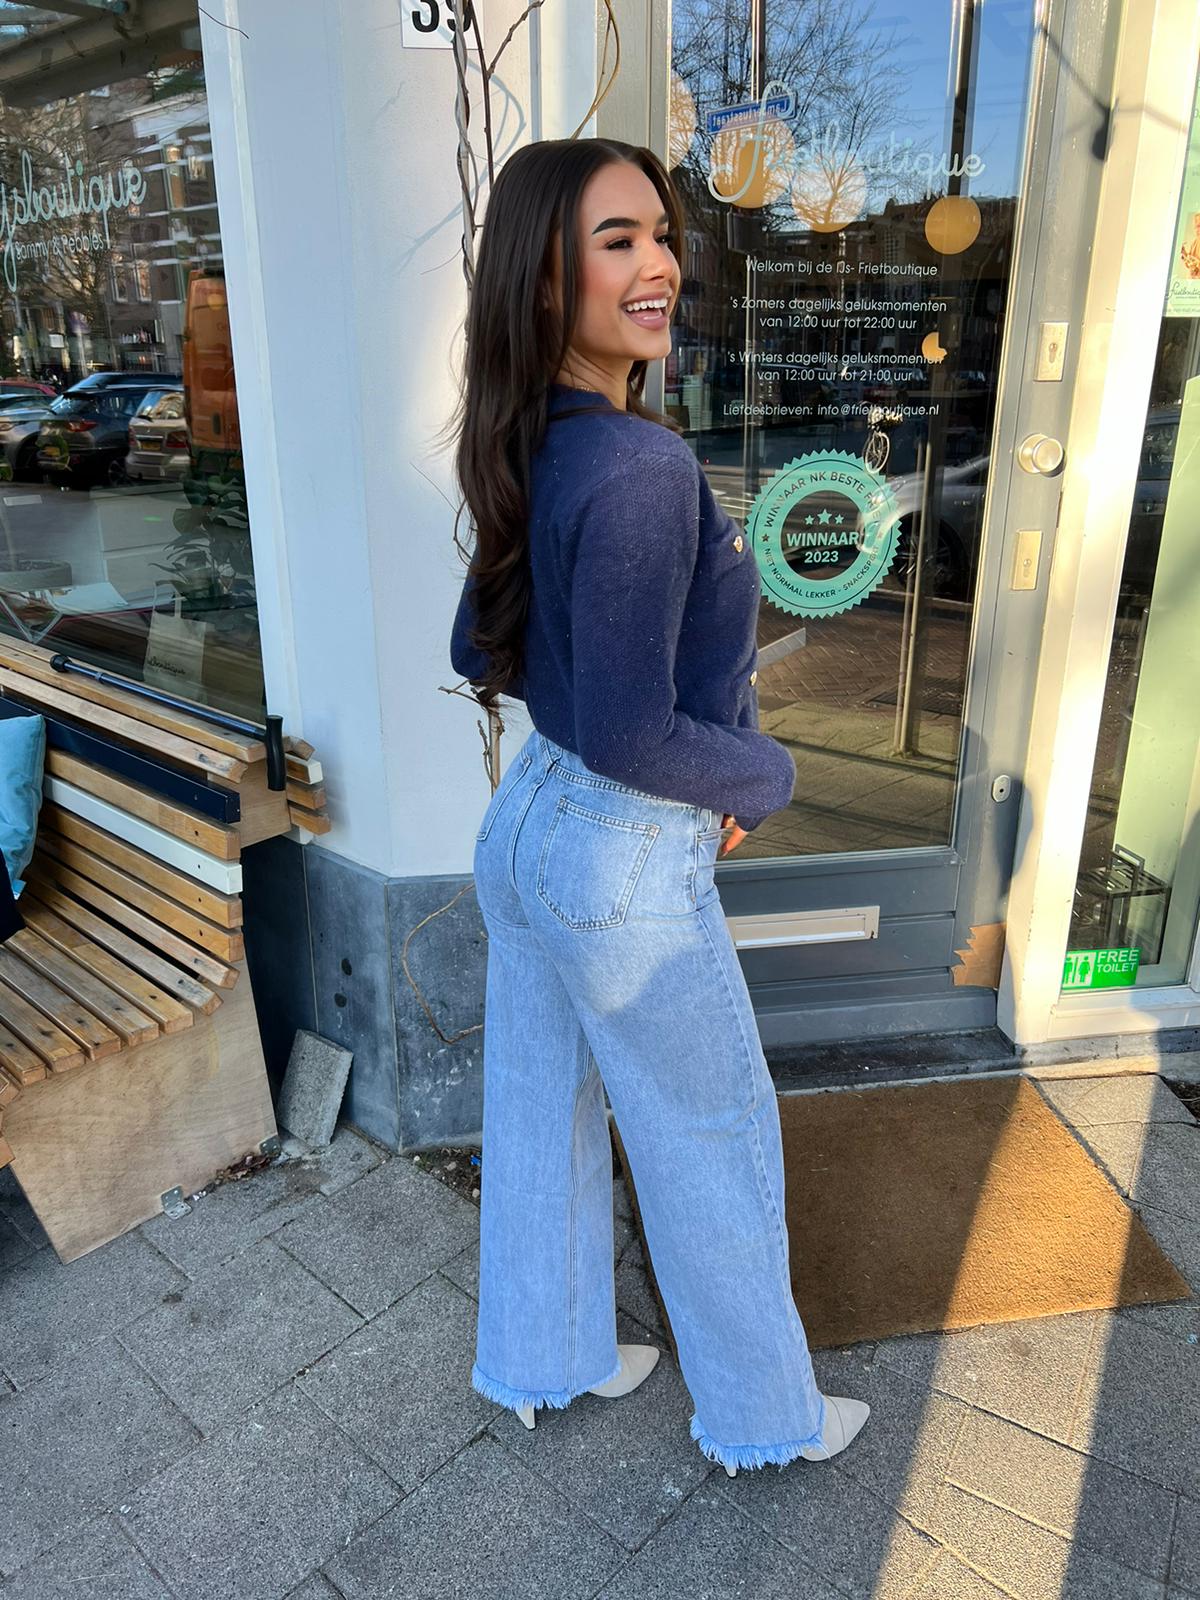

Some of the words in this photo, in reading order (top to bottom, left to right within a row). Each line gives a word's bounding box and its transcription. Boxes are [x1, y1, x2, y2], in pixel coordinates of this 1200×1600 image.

[62, 229, 105, 253] Pebbles
[745, 259, 795, 273] Welkom
[797, 260, 813, 275] bij
[815, 260, 833, 273] de
[858, 262, 938, 277] Frietboutique
[729, 296, 738, 309] 's
[741, 296, 786, 310] Zomers
[788, 298, 842, 312] dagelijks
[844, 298, 947, 313] geluksmomenten
[759, 317, 783, 328] van
[787, 315, 819, 329] 12:00
[821, 317, 841, 329] uur
[843, 316, 861, 329] tot
[863, 316, 896, 329] 22:00
[897, 318, 918, 330] uur
[727, 351, 736, 363] 's
[738, 351, 783, 364] Winters
[785, 351, 839, 366] dagelijks
[757, 371, 781, 381] van
[784, 369, 816, 381] 12:00
[817, 371, 837, 381] uur
[839, 368, 857, 382] tot
[859, 369, 891, 382] 21:00
[893, 373, 913, 382] uur
[723, 403, 814, 417] Liefdesbrieven:
[763, 477, 806, 528] WINNAAR
[809, 471, 827, 483] NK
[830, 471, 866, 494] BESTE
[786, 531, 860, 547] WINNAAR
[804, 550, 840, 564] 2023
[764, 547, 776, 567] NIET
[771, 567, 803, 597] NORMAAL
[805, 589, 837, 599] LEKKER
[1096, 949, 1140, 964] FREE
[1096, 961, 1137, 973] TOILET
